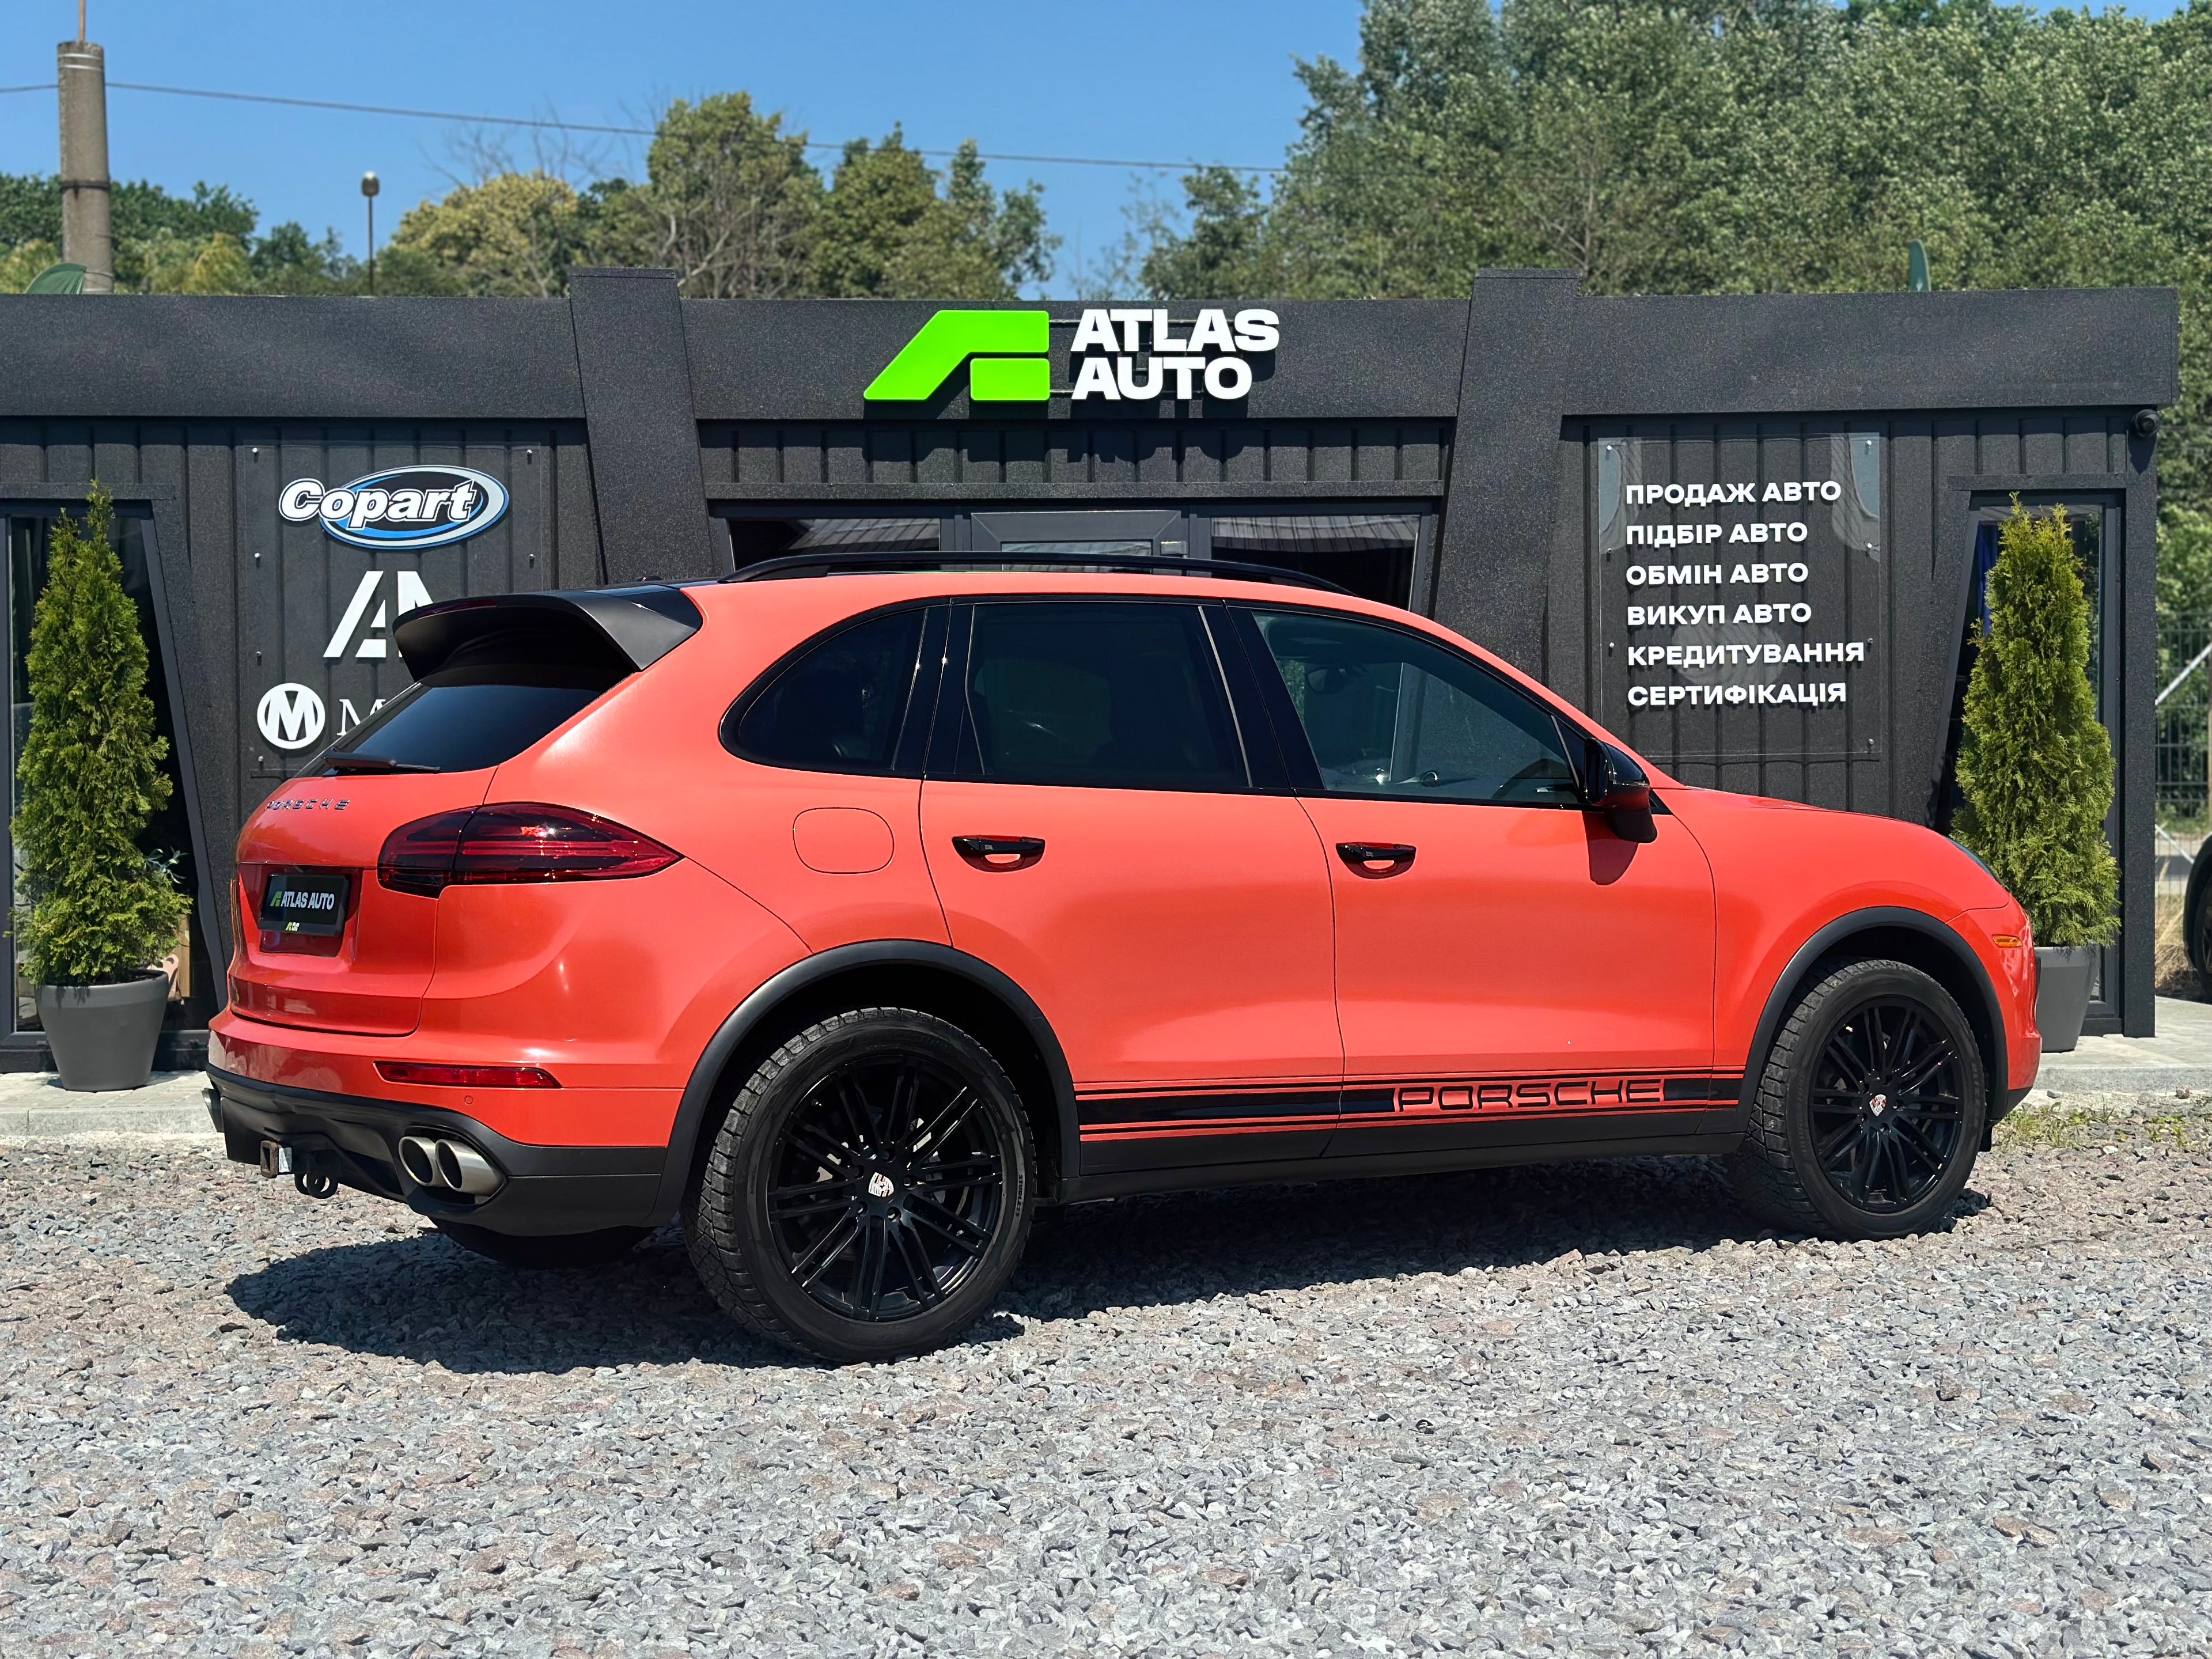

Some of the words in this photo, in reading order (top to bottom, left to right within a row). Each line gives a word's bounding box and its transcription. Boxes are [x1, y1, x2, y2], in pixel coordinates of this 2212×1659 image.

[1070, 309, 1279, 352] ATLAS
[1070, 357, 1253, 400] AUTO
[279, 478, 477, 530] Copart
[1626, 482, 1756, 507] ПРОДАЖ
[1762, 480, 1842, 502] АВТО
[1626, 524, 1722, 548] ПІДБІР
[1728, 521, 1808, 543] АВТО
[1626, 564, 1722, 585] ОБМІН
[1729, 562, 1809, 584] АВТО
[1627, 605, 1725, 626] ВИКУП
[1732, 603, 1812, 624] АВТО
[1627, 642, 1864, 668] КРЕДИТУВАННЯ
[1627, 682, 1846, 706] СЕРТИФІКАЦІЯ
[265, 798, 350, 810] PORSCHE
[281, 891, 308, 908] ATLAS
[308, 892, 335, 910] AUTO
[1399, 1080, 1661, 1112] PORSCHE
